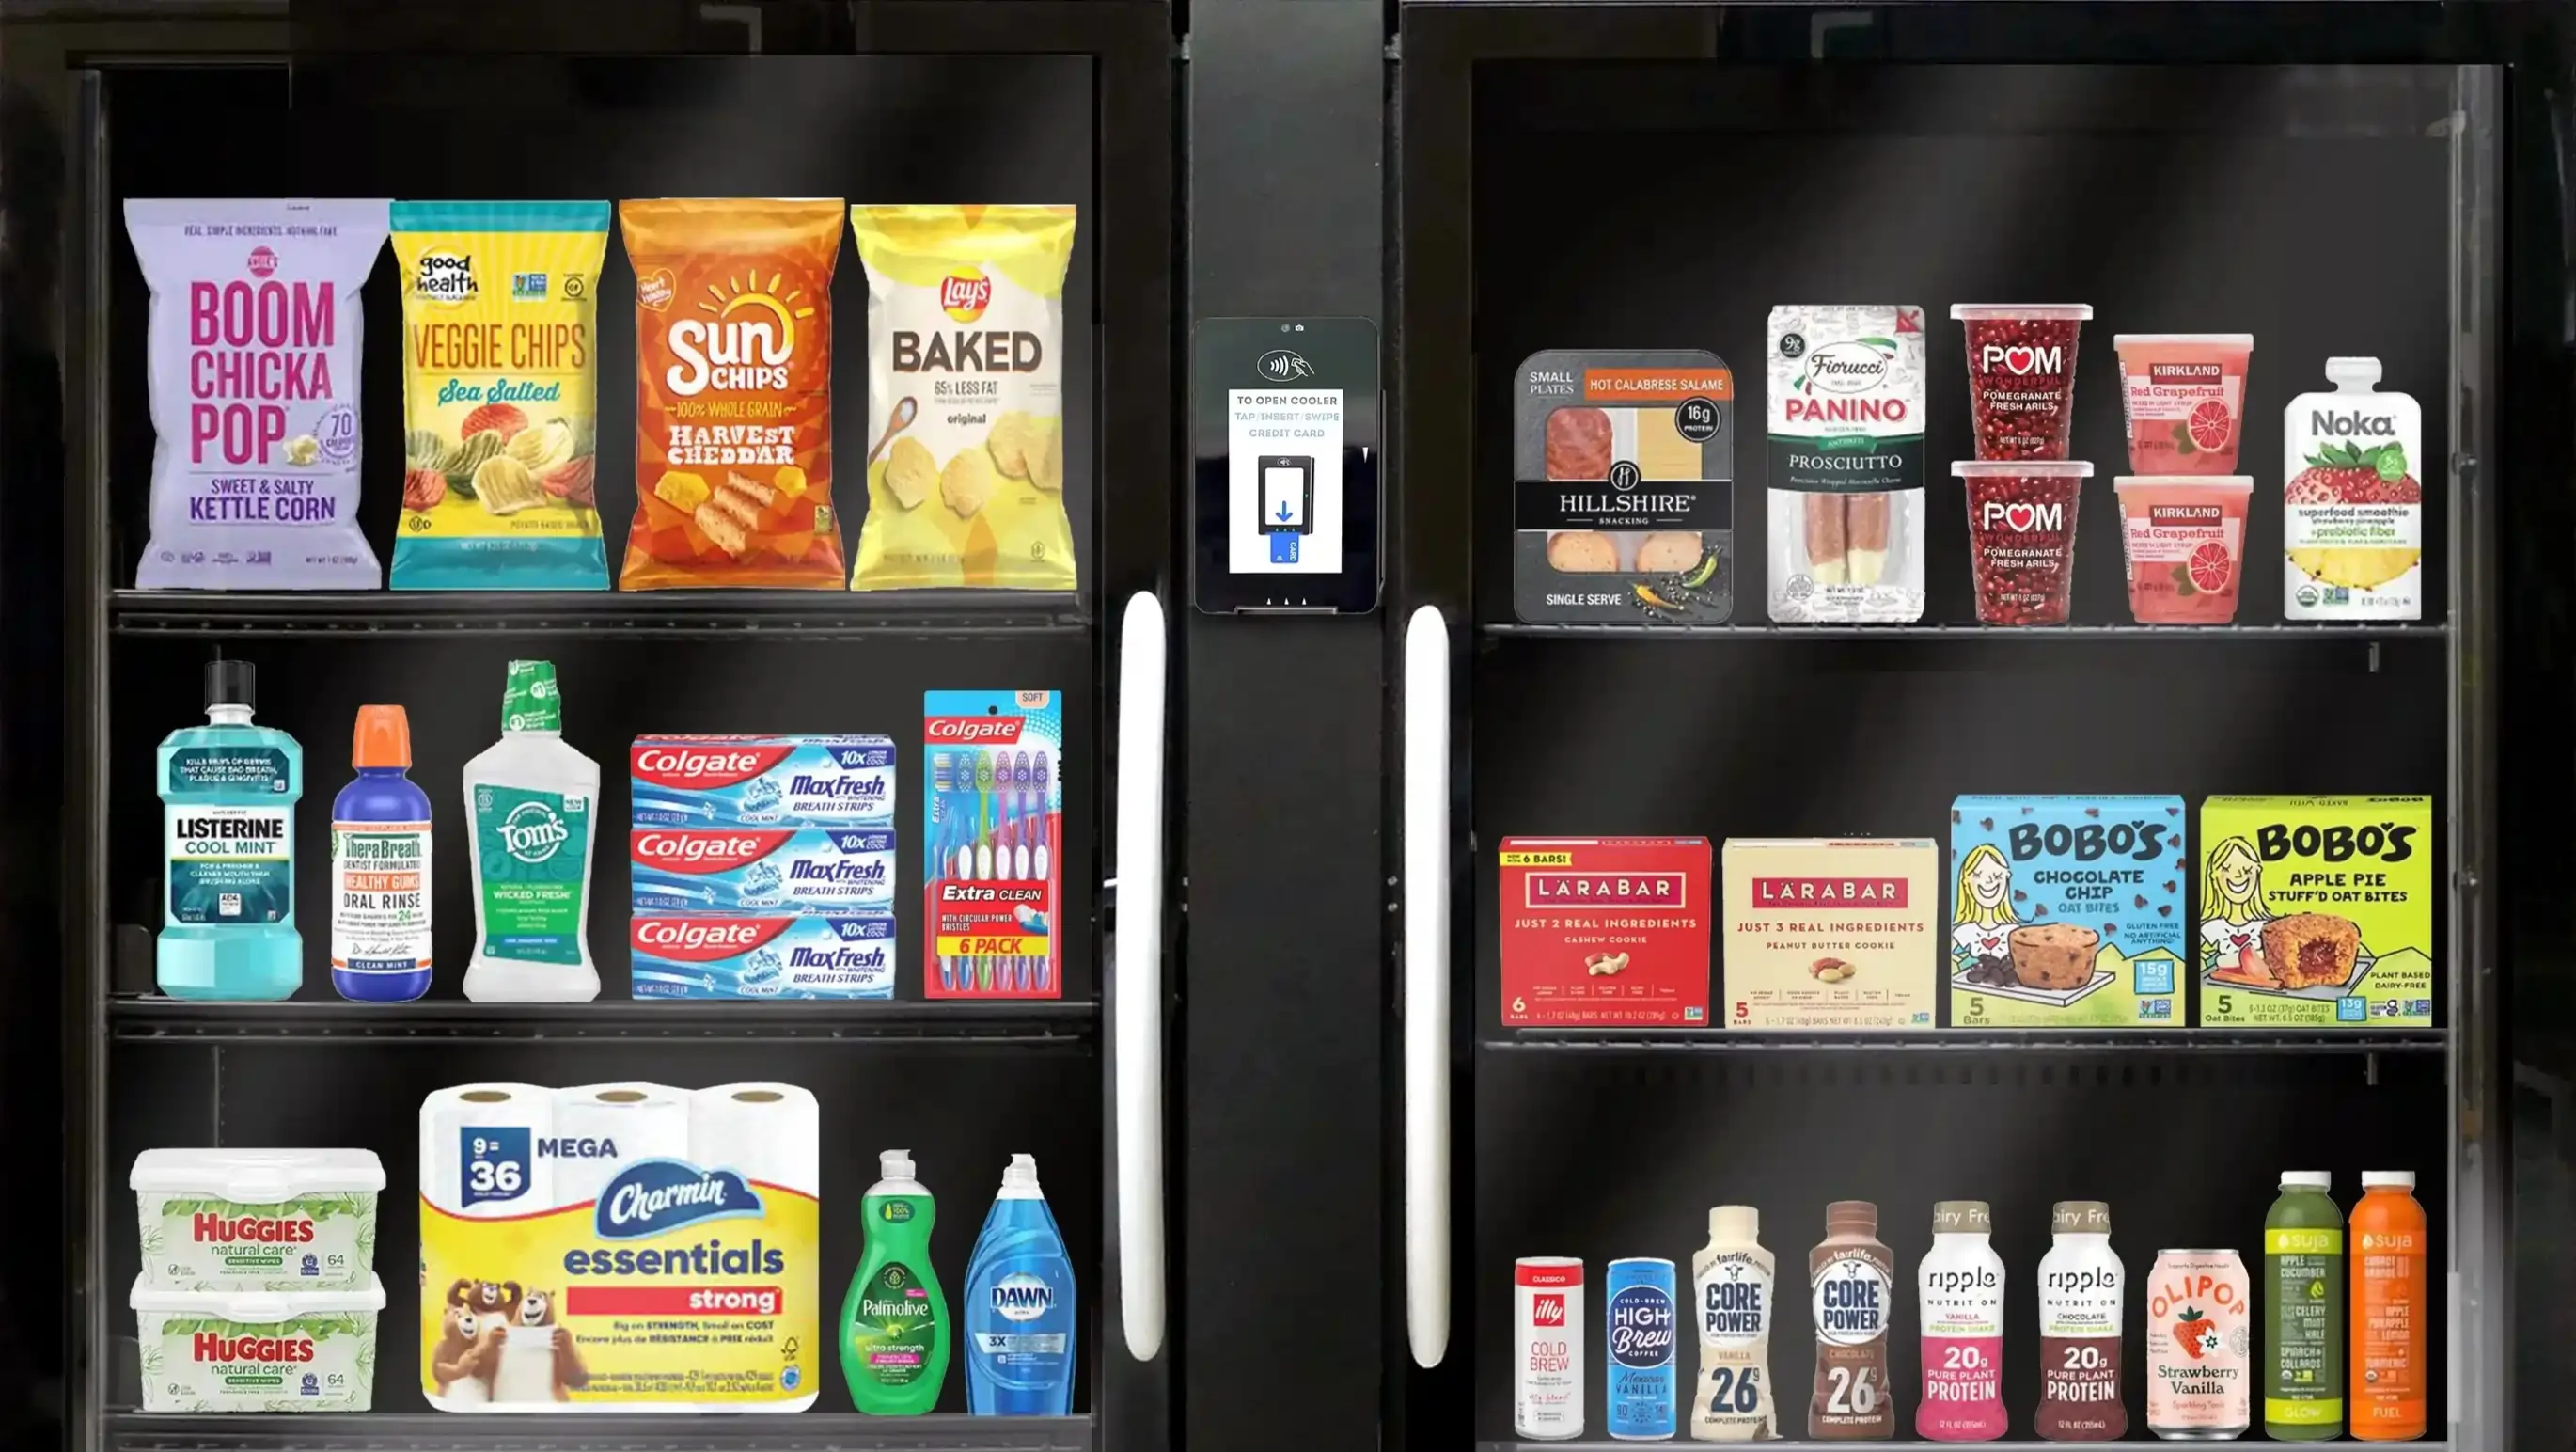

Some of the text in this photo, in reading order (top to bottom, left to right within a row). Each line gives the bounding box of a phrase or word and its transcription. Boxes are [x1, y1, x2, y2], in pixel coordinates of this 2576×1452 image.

[419, 255, 471, 276] good
[416, 273, 478, 293] health
[943, 276, 989, 309] Lay's
[191, 281, 334, 347] BOOM
[414, 324, 585, 369] VEGGIE CHIPS
[893, 331, 1042, 372] BAKED
[667, 319, 794, 396] Sun
[1983, 346, 2061, 375] POM
[1811, 354, 1885, 378] Fiorucci
[2153, 365, 2221, 376] KIRKLAND
[191, 351, 333, 400] CHICKA
[711, 367, 788, 390] CHIPS
[1530, 371, 1573, 383] SMALL
[438, 378, 560, 406] Sea Salted
[935, 381, 998, 396] 65% LESS FAT
[1530, 384, 1574, 395] PLATES
[1590, 379, 1723, 391] HOT CALABRESE SALAME
[2131, 387, 2224, 399] Red Grapefruit
[1237, 396, 1338, 405] TO OPEN COOLER
[1983, 391, 2062, 401] POMEGRANATE
[676, 402, 782, 418] 100% WHOLE GRAIN
[1785, 398, 1908, 422] PANINO
[1990, 402, 2054, 411] FRESH ARILS
[948, 413, 987, 426] original
[2311, 410, 2395, 436] Noka
[191, 403, 286, 464] POP
[669, 425, 794, 447] HARVEST
[1249, 429, 1325, 437] CREDIT CARD
[668, 445, 794, 466] CHEDDAR
[1789, 454, 1902, 470] PROSCIUTTO
[212, 479, 314, 495] SWEET & SALTY
[190, 497, 335, 520] KETTLE CORN
[1560, 495, 1691, 513] HILLSHIRE
[2299, 507, 2409, 517] superfood smoothie
[2153, 507, 2221, 518] KIRKLAND
[1547, 593, 1622, 606] SINGLE SERVE
[1022, 692, 1044, 702] SOFT
[637, 750, 757, 778] Colgate
[840, 750, 866, 765] 10x
[793, 802, 874, 812] BREATH STRIPS
[177, 818, 284, 839] LISTERINE
[496, 813, 569, 854] Tom's
[185, 842, 275, 854] COOL MINT
[637, 834, 757, 862] Colgate
[2008, 820, 2168, 861] BOBO'S
[2257, 822, 2417, 862] BOBO'S
[1523, 855, 1566, 863] 6 BARS!
[2034, 870, 2144, 884] CHOCOLATE
[2289, 874, 2386, 886] APPLE PIE
[343, 893, 421, 909] ORAL RINSE
[942, 885, 1042, 901] Extra CLEAN
[2065, 887, 2113, 900] CHIP
[2269, 891, 2408, 902] STUFF'D OAT BITES
[2058, 902, 2120, 913] OAT BITES
[1515, 919, 1697, 929] JUST 2 REAL INGREDIENTS
[1737, 923, 1924, 932] JUST 3 REAL INGREDIENTS
[960, 939, 1024, 955] 6 PACK
[1564, 936, 1647, 944] CASHEW COOKIE
[1512, 997, 1526, 1012] 6
[1736, 1002, 1749, 1018] 5
[1970, 997, 1984, 1016] 5
[1963, 1016, 1990, 1025] Bars
[2205, 1014, 2245, 1022] Oat Bites
[537, 1138, 619, 1159] MEGA
[470, 1161, 521, 1192] 36
[609, 1172, 725, 1223] Charmin
[194, 1213, 314, 1243] HUGGIES
[212, 1244, 293, 1255] natural care
[2292, 1235, 2329, 1252] suja
[327, 1255, 344, 1265] 64
[564, 1239, 784, 1275] essentials
[1928, 1266, 1996, 1293] ripple
[689, 1289, 776, 1315] strong
[991, 1286, 1053, 1308] DAWN
[1706, 1283, 1761, 1311] CORE
[1824, 1280, 1879, 1308] CORE
[2152, 1275, 2244, 1318] OLIPOP
[863, 1299, 929, 1316] Palmolive
[1534, 1299, 1563, 1324] illy
[2295, 1305, 2326, 1317] CELERY
[1614, 1307, 1671, 1326] HIGH
[1706, 1312, 1762, 1332] POWER
[1824, 1309, 1878, 1330] POWER
[989, 1336, 1006, 1347] 3X
[1612, 1326, 1672, 1353] Brew
[194, 1333, 314, 1363] HUGGIES
[1531, 1342, 1566, 1356] COLD
[1530, 1357, 1569, 1372] BREW
[327, 1374, 344, 1384] 64
[1927, 1369, 1995, 1380] PURE PLANT
[2157, 1365, 2239, 1381] Strawberry
[1927, 1381, 1996, 1401] PROTEIN
[2171, 1381, 2225, 1395] Vanilla
[2373, 1408, 2402, 1418] FUEL
